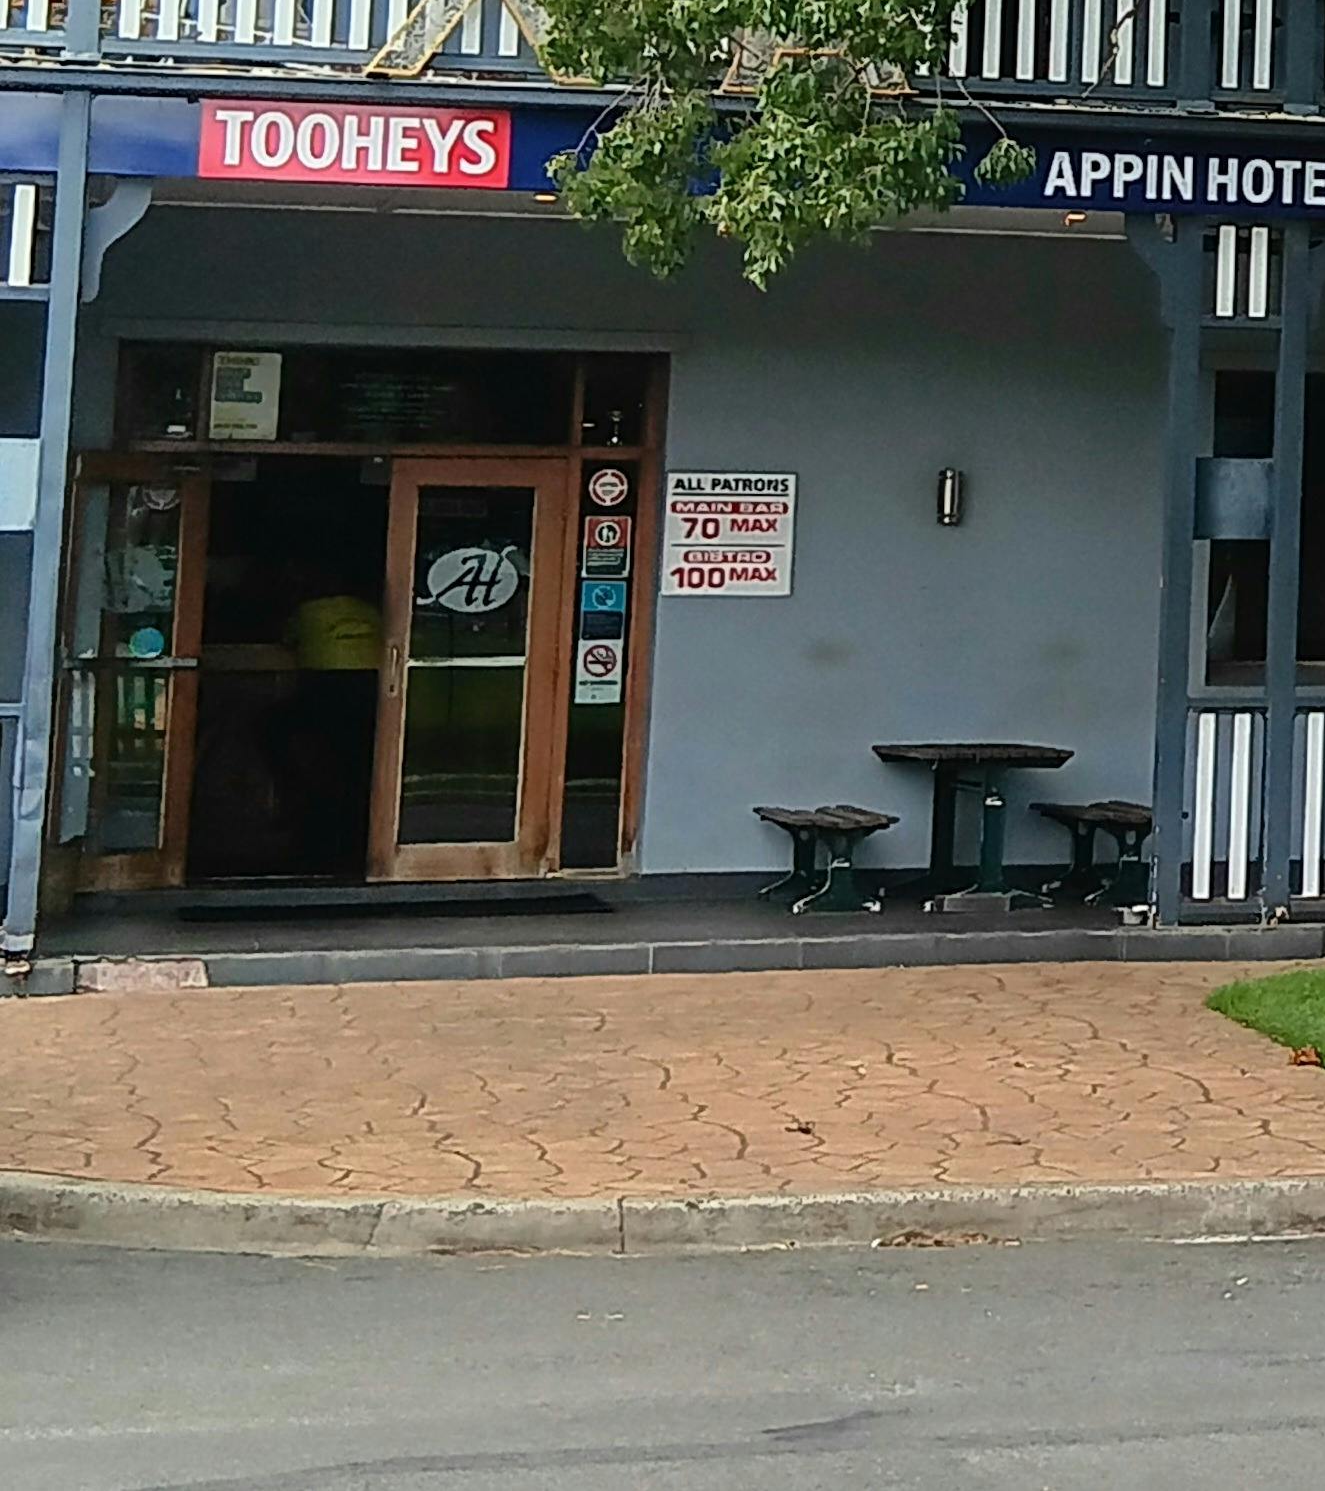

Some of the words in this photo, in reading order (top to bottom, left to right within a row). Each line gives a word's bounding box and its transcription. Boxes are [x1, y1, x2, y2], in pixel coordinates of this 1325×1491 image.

[214, 110, 497, 176] TOOHEYS
[1043, 151, 1194, 201] APPIN
[673, 477, 705, 491] ALL
[710, 477, 789, 493] PATRONS
[675, 502, 733, 513] MAIN
[739, 502, 785, 514] BAR
[681, 517, 721, 540] 70
[729, 518, 778, 533] MAX
[687, 551, 768, 563] BISTRO
[670, 566, 726, 589] 100
[728, 567, 778, 582] MAX
